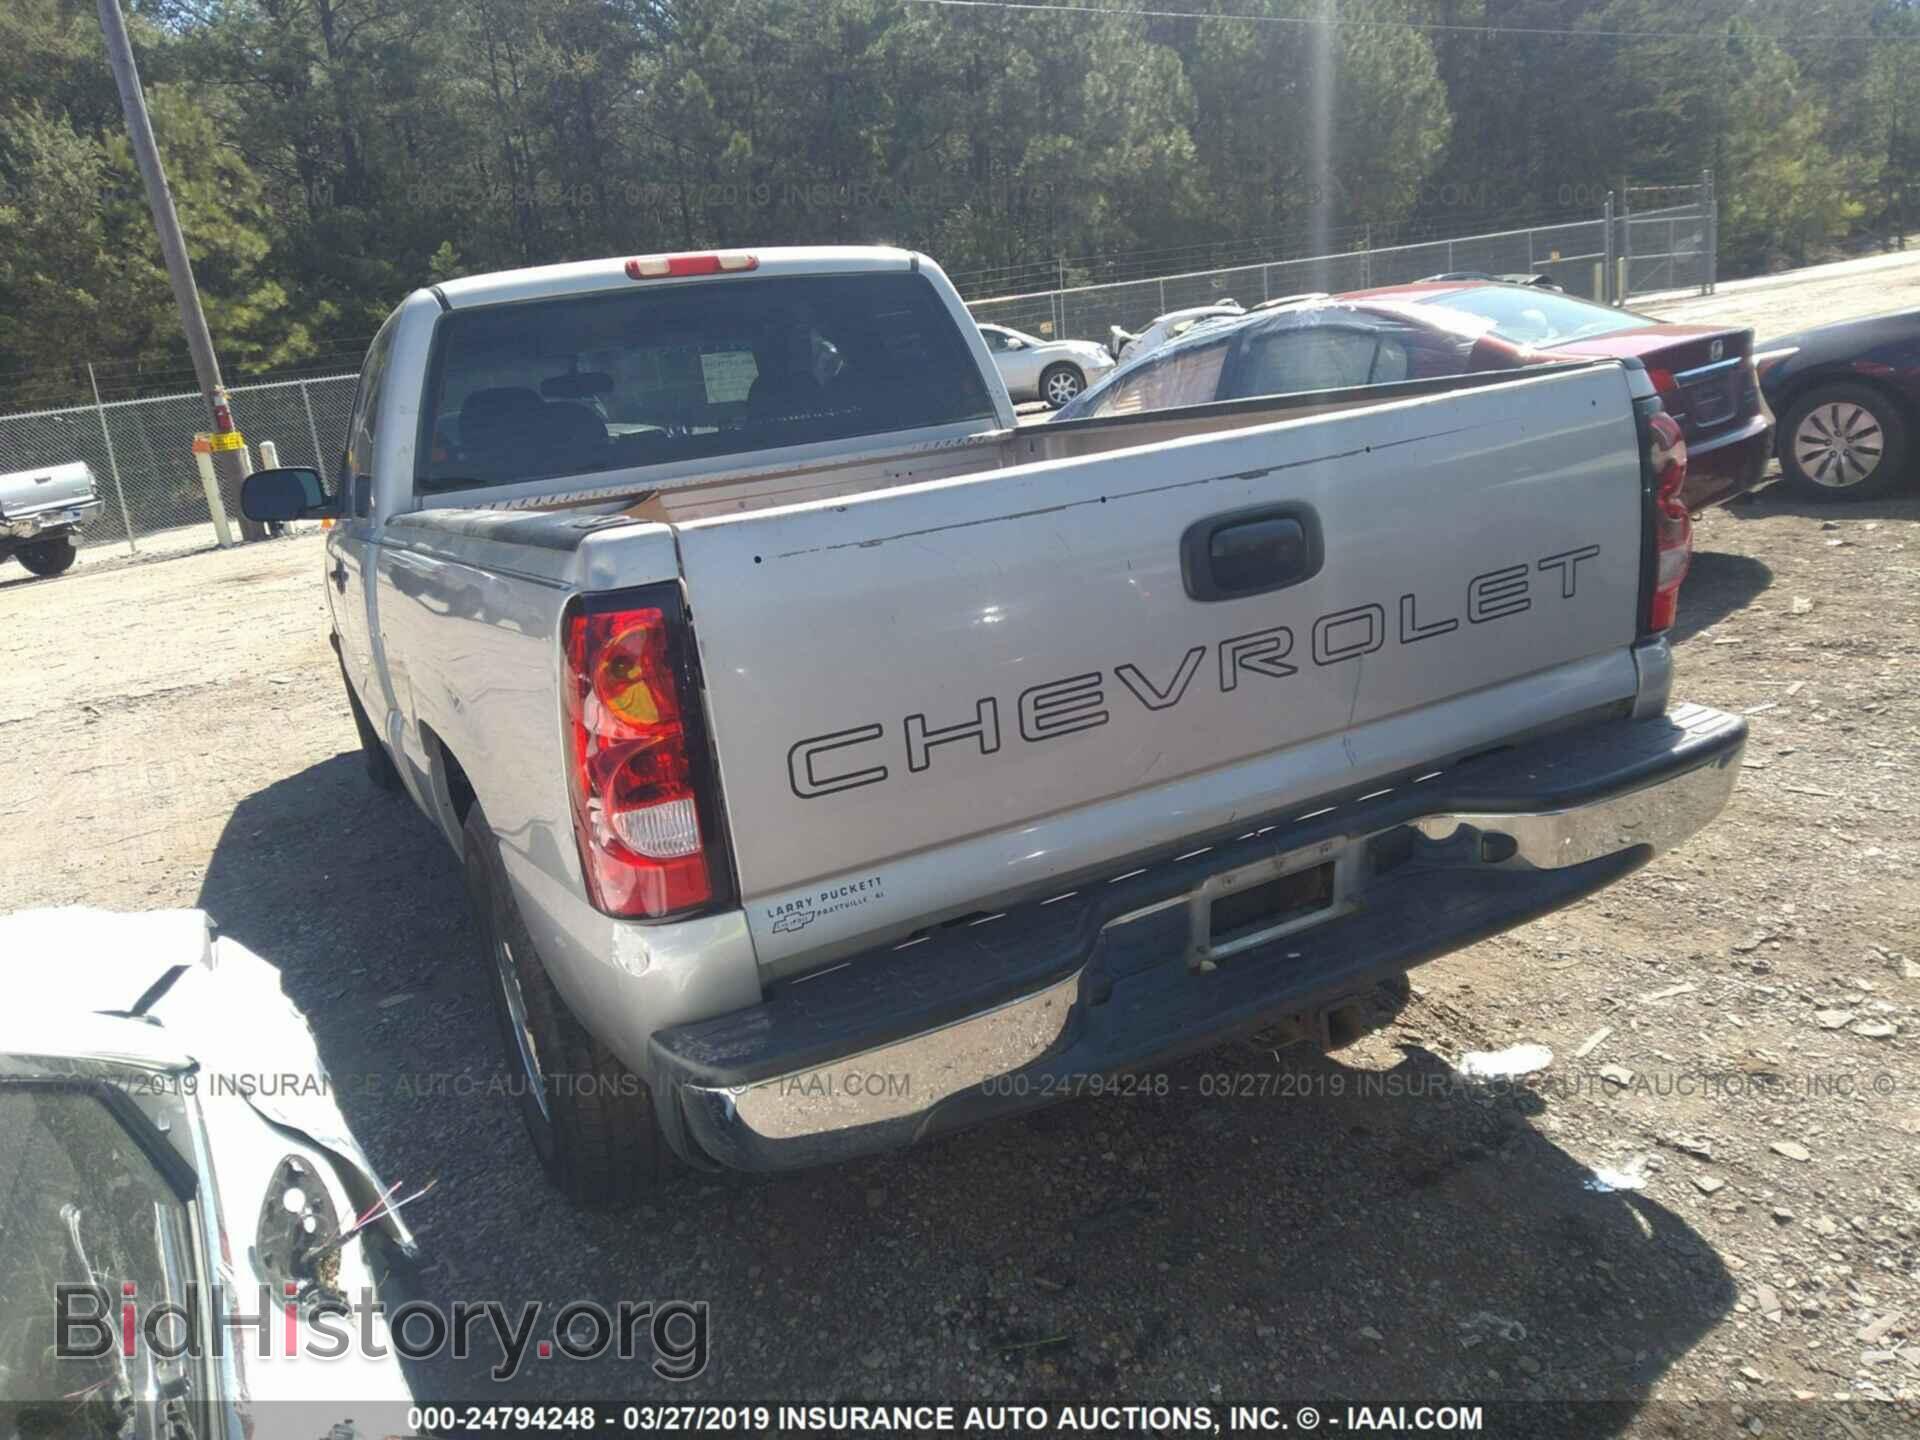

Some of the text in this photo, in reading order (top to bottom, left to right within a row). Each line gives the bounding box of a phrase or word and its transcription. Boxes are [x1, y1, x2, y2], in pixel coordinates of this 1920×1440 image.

[788, 545, 1599, 798] CHEVROLET
[767, 876, 881, 918] LARRY PUCKETT
